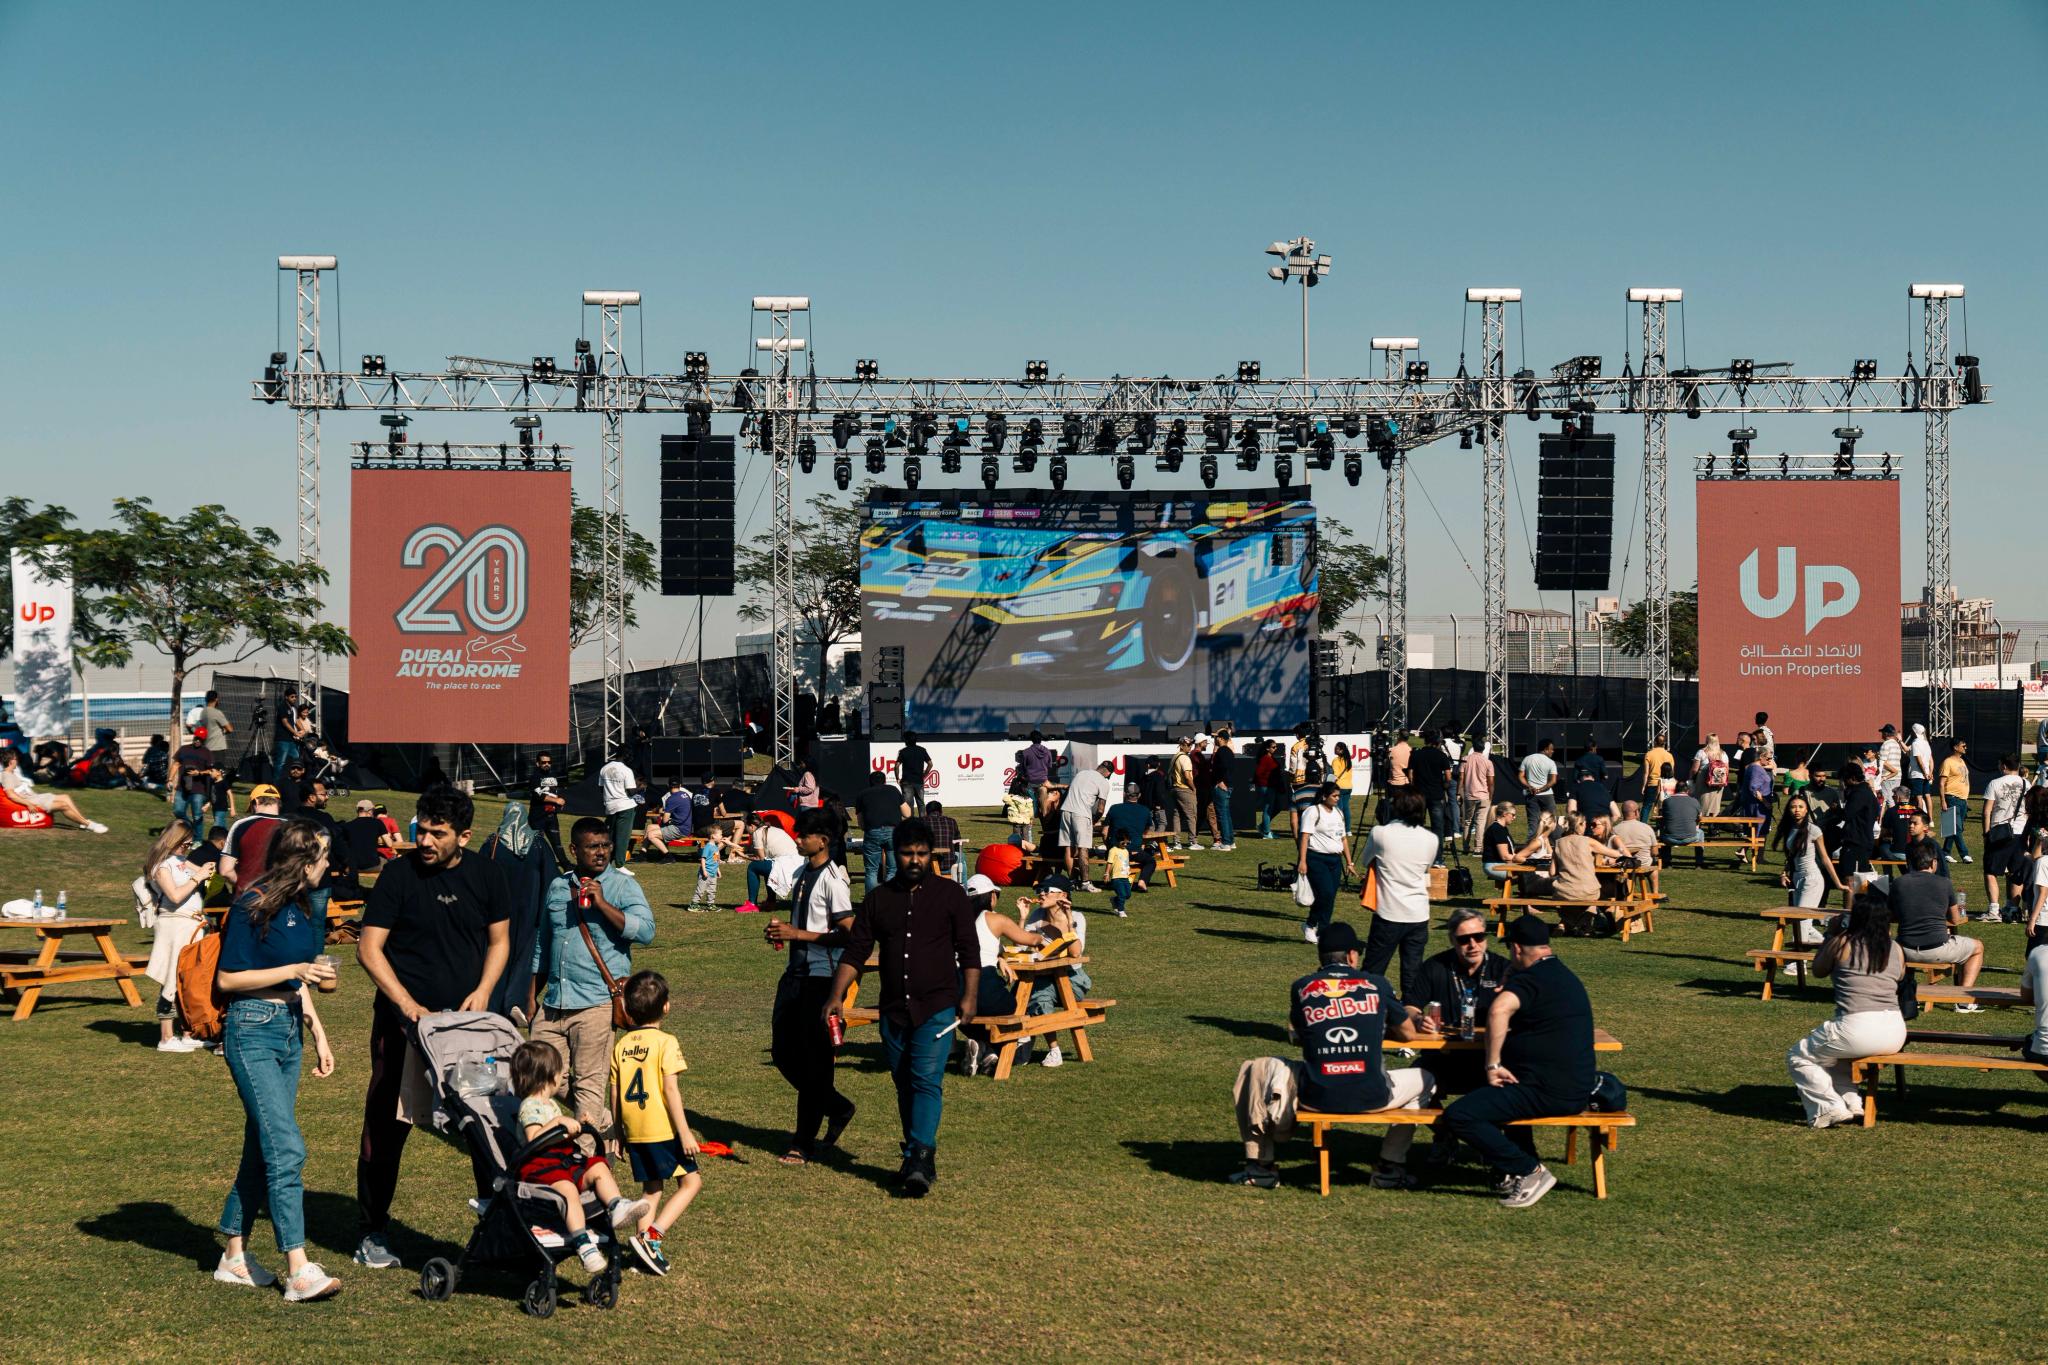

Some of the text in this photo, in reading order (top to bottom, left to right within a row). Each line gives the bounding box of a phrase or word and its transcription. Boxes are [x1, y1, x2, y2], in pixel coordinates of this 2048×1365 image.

[393, 523, 528, 635] 20
[1215, 578, 1235, 606] 21
[400, 649, 462, 663] DUBAI
[1816, 644, 1861, 658] الاتحاد
[396, 664, 521, 678] AUTODROME
[1740, 662, 1862, 678] Union Properties
[443, 682, 467, 690] place
[470, 682, 479, 690] to
[1303, 993, 1379, 1026] Red Bull
[622, 1045, 650, 1062] halley
[1318, 1044, 1369, 1054] INFINITI
[1323, 1062, 1362, 1073] TOTAL
[626, 1067, 649, 1110] 4
